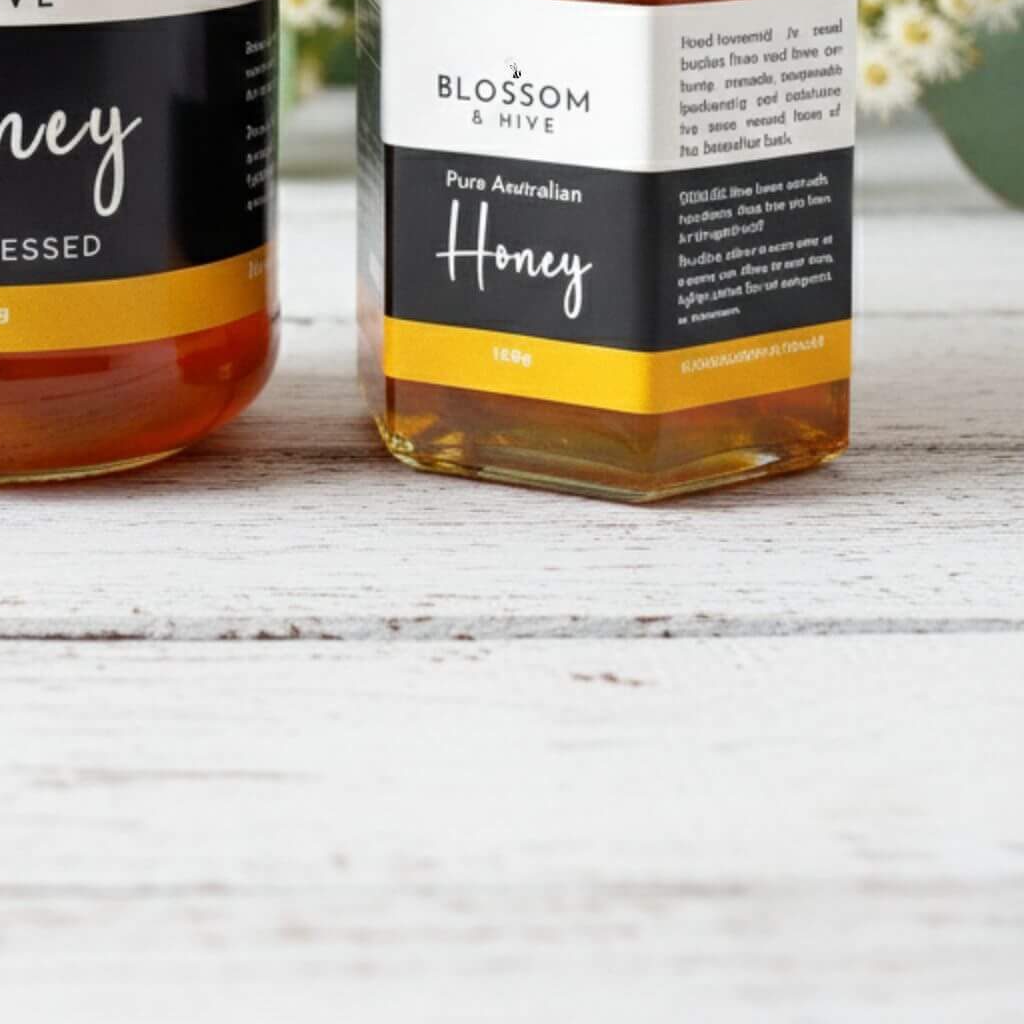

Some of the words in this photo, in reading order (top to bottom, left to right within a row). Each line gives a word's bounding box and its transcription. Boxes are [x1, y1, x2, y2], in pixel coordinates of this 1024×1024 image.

[437, 74, 590, 113] BLOSSOM
[470, 109, 484, 126] &
[498, 113, 555, 134] HIVE
[445, 168, 487, 192] Pure
[435, 199, 593, 319] Honey
